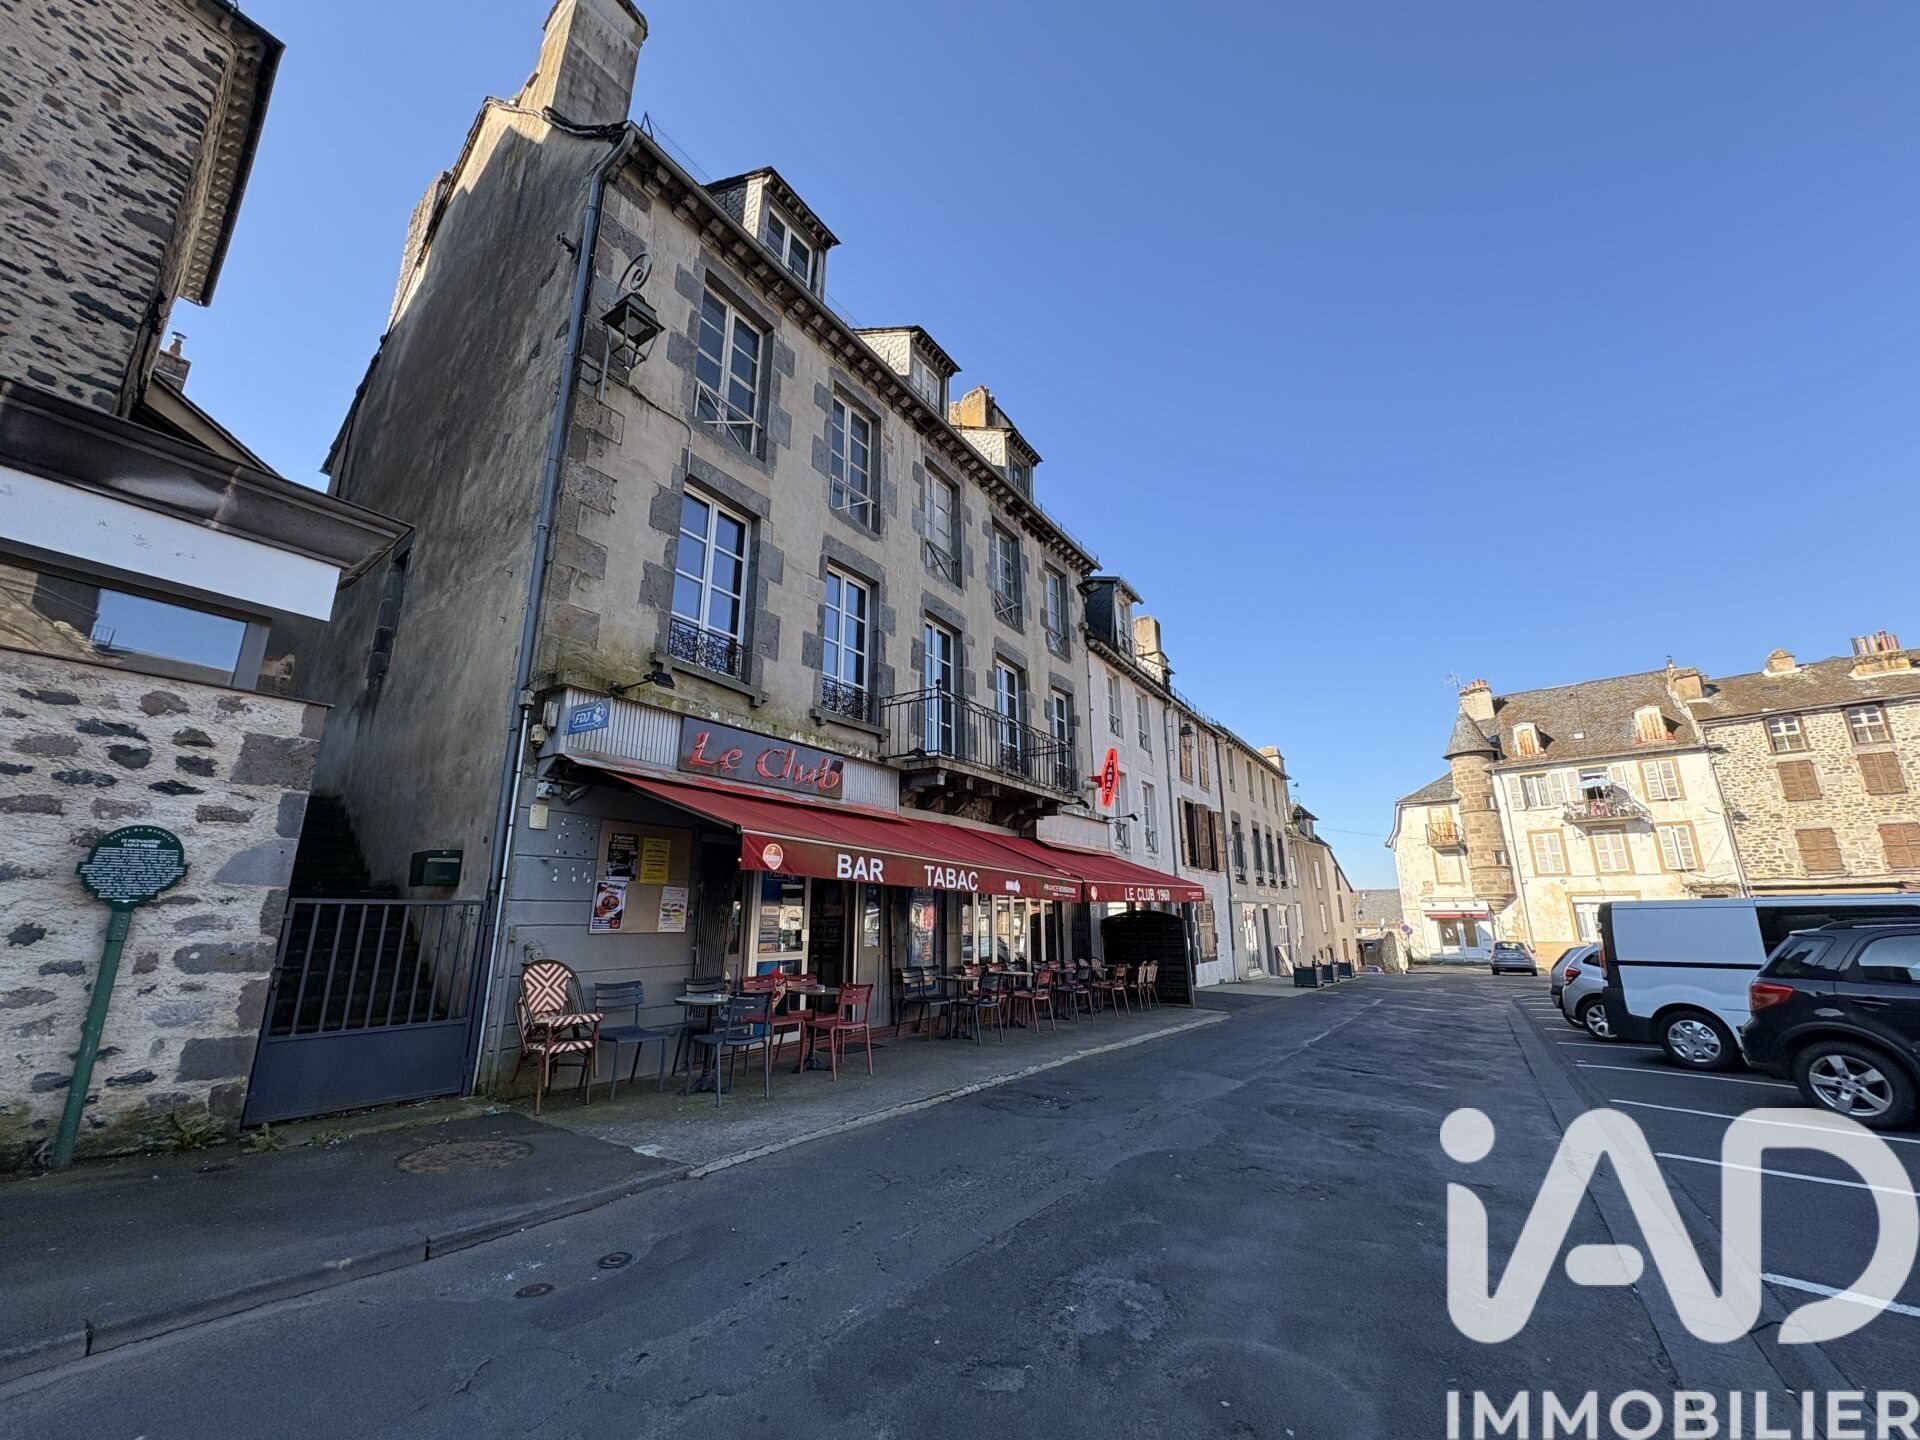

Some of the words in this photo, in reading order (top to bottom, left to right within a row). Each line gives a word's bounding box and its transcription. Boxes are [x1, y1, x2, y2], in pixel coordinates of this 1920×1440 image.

[574, 711, 591, 725] FDJ
[689, 731, 743, 772] Le
[755, 748, 840, 790] Club
[1105, 759, 1114, 795] TABAC
[836, 853, 884, 883] BAR
[923, 865, 979, 891] TABAC
[1124, 887, 1135, 901] LE
[1137, 888, 1155, 901] CLUB
